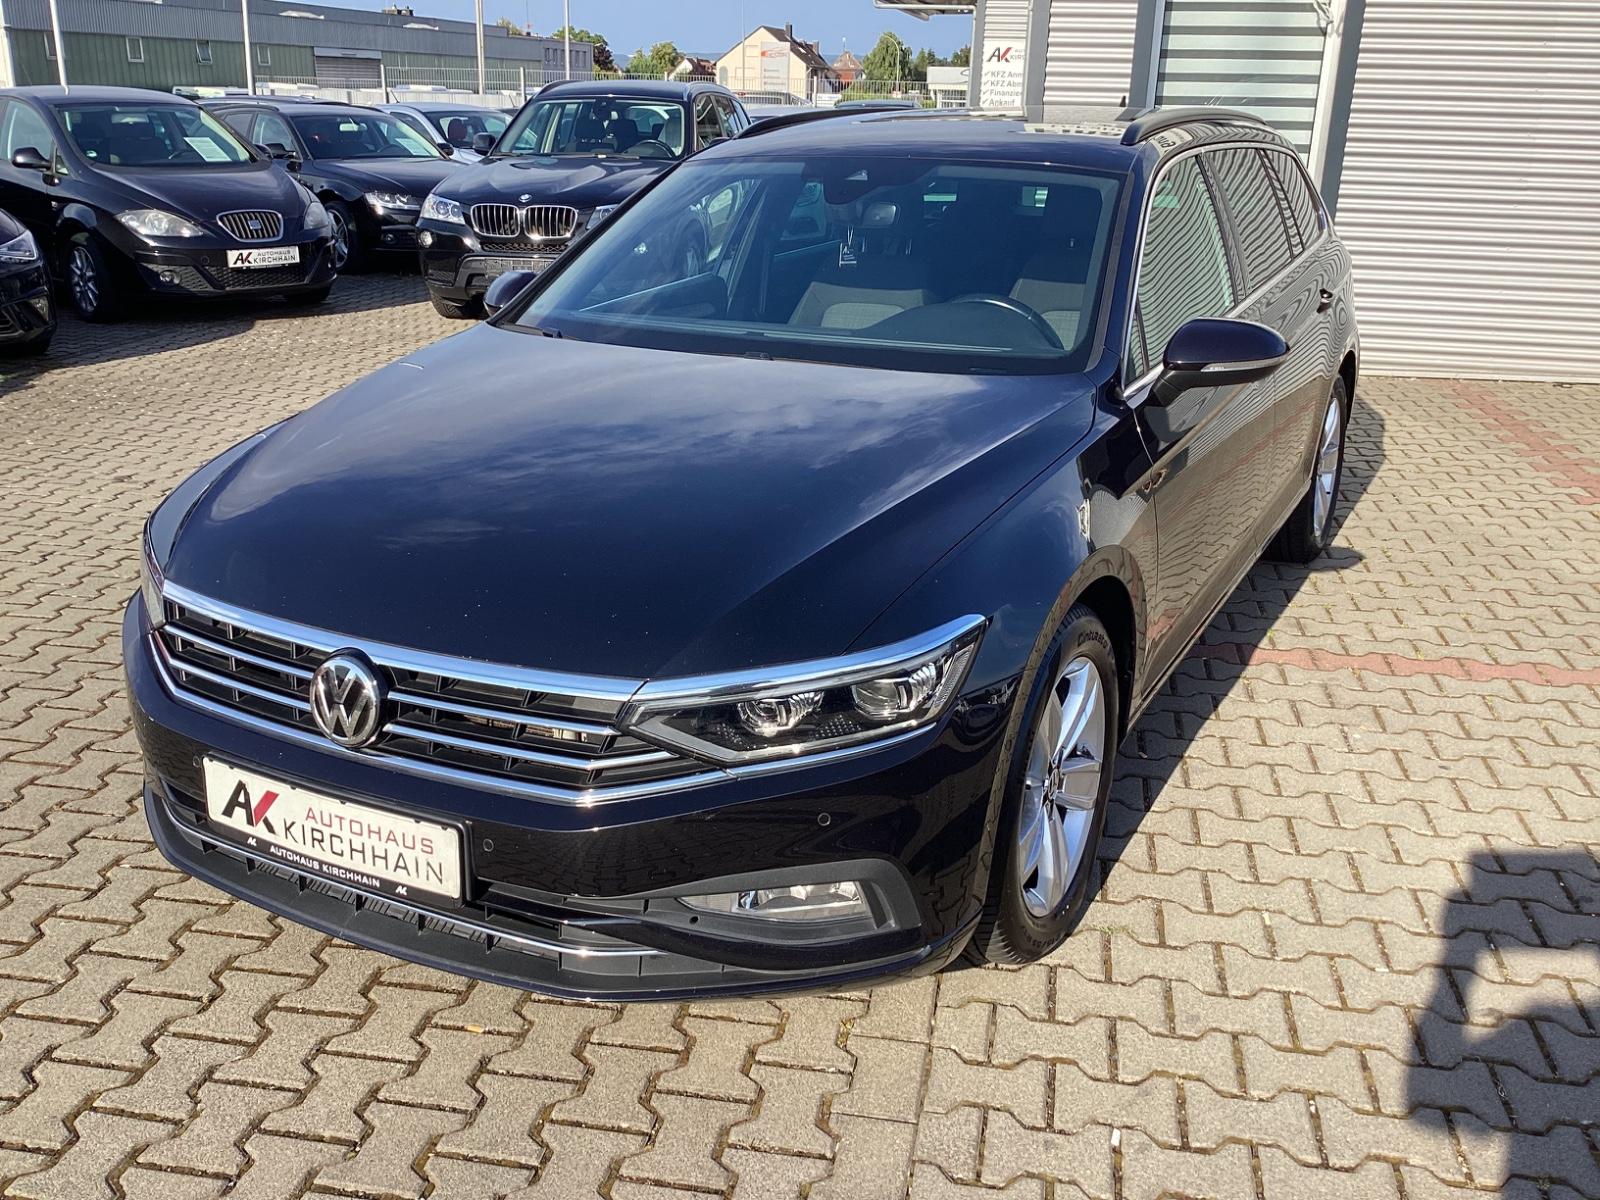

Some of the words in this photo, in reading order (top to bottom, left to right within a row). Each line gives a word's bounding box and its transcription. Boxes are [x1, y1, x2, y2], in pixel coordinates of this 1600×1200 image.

[986, 47, 1012, 63] AK
[991, 70, 1006, 78] KFZ
[990, 80, 1006, 88] KFZ
[988, 99, 1015, 107] Ankauf
[233, 252, 252, 265] AK
[253, 255, 296, 264] KIRCHHAIN
[311, 657, 378, 744] VW
[221, 779, 280, 835] AK
[304, 806, 434, 855] AUTOHAUS
[283, 818, 443, 885] KIRCHHAIN
[269, 844, 320, 870] AUTOHAUS
[322, 864, 381, 888] KIRCHHAIN
